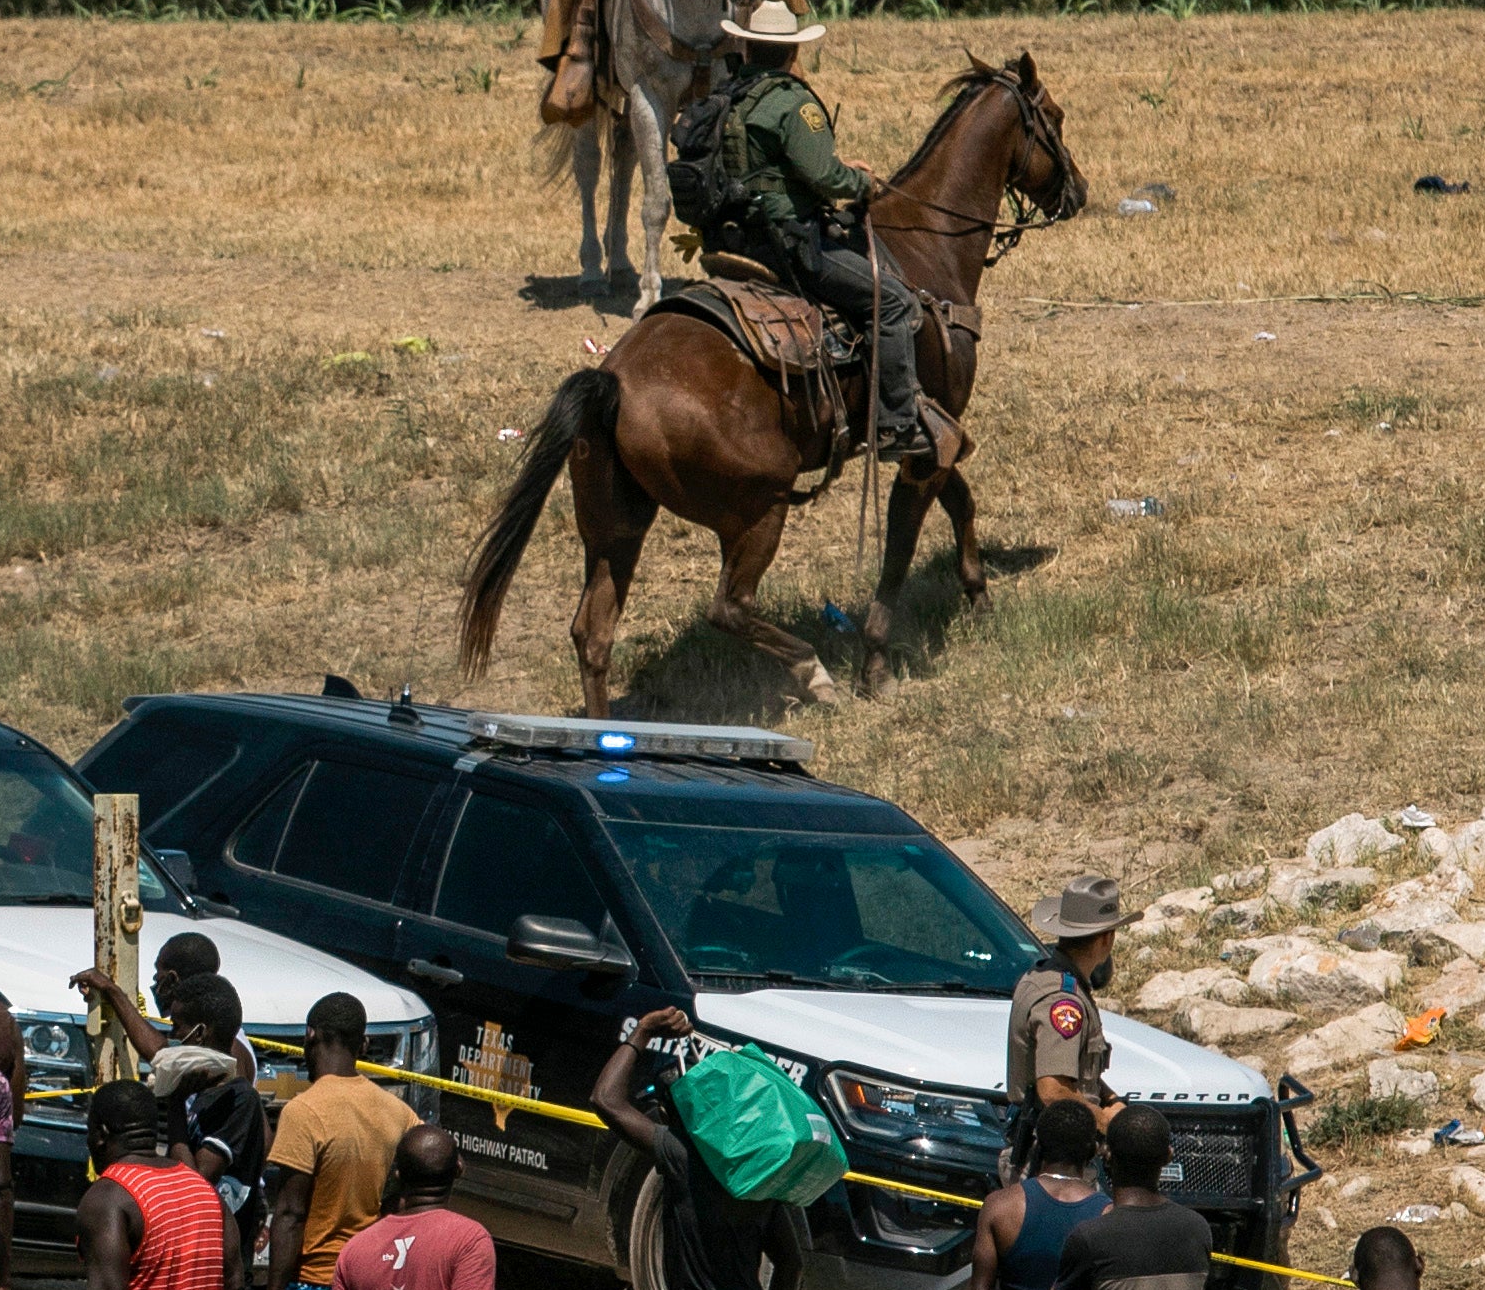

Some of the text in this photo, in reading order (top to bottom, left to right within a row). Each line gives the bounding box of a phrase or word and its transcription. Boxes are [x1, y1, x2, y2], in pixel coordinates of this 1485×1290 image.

[477, 1026, 514, 1052] TEXAS
[458, 1044, 535, 1080] DEPARTMENT
[452, 1065, 496, 1091] PUBLIC
[498, 1078, 542, 1101] SAFETY
[1126, 1091, 1251, 1102] CEPTOR
[461, 1133, 509, 1160] HIGHWAY
[509, 1145, 549, 1170] PATROL
[382, 1254, 395, 1262] the
